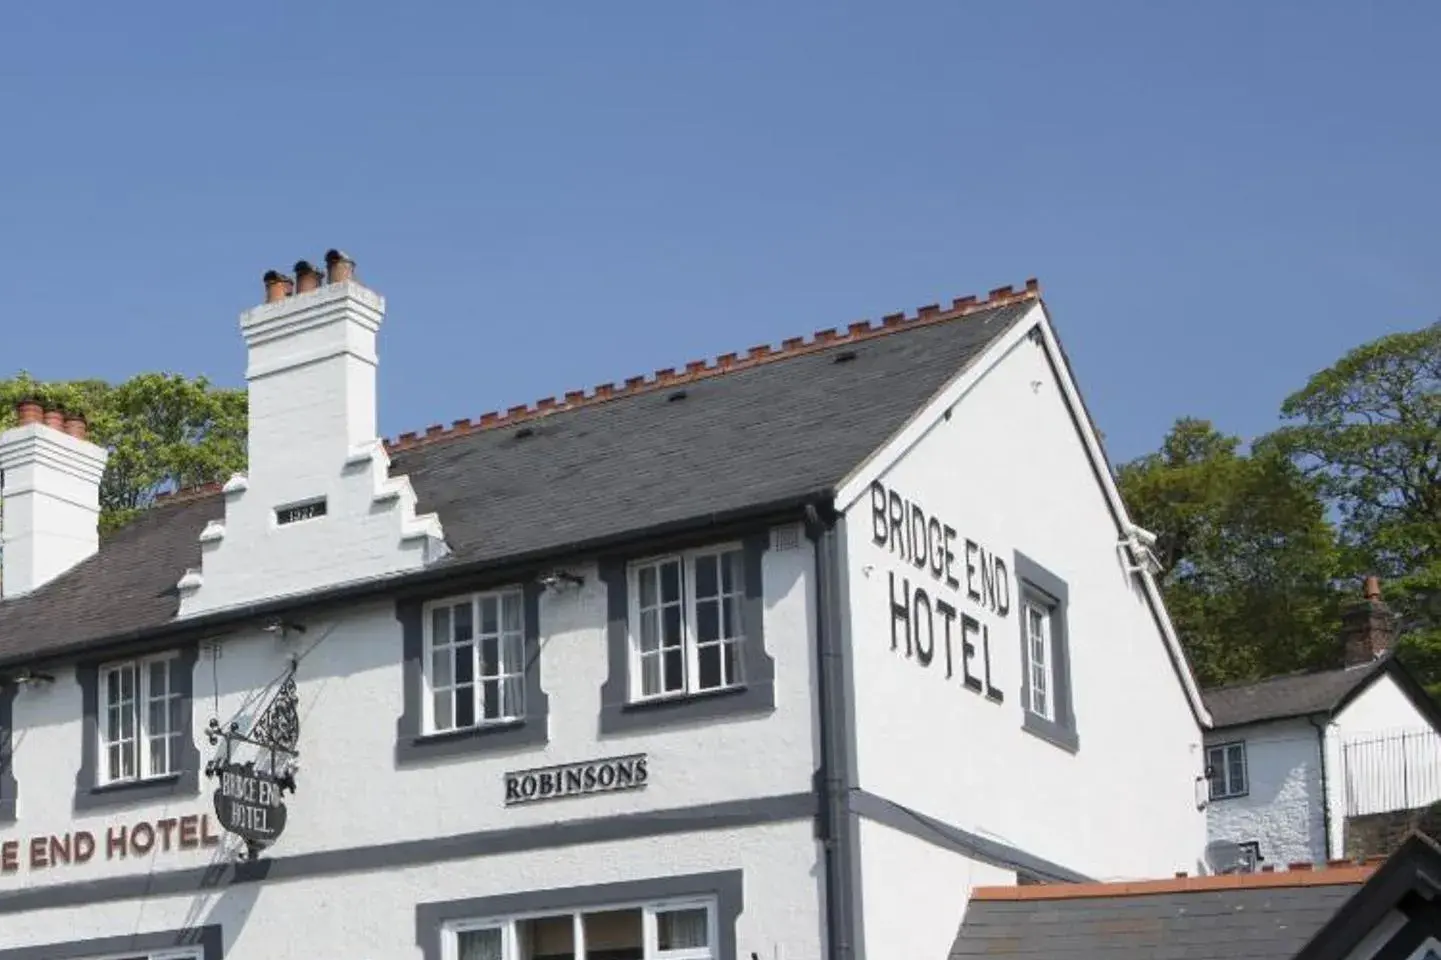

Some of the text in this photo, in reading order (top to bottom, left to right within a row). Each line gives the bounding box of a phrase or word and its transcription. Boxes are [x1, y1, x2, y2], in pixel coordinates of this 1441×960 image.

[871, 479, 1010, 618] BRIDGE END
[888, 570, 1005, 706] HOTEL
[506, 758, 648, 801] ROBINSONS
[30, 832, 96, 870] END
[107, 814, 219, 861] HOTEL
